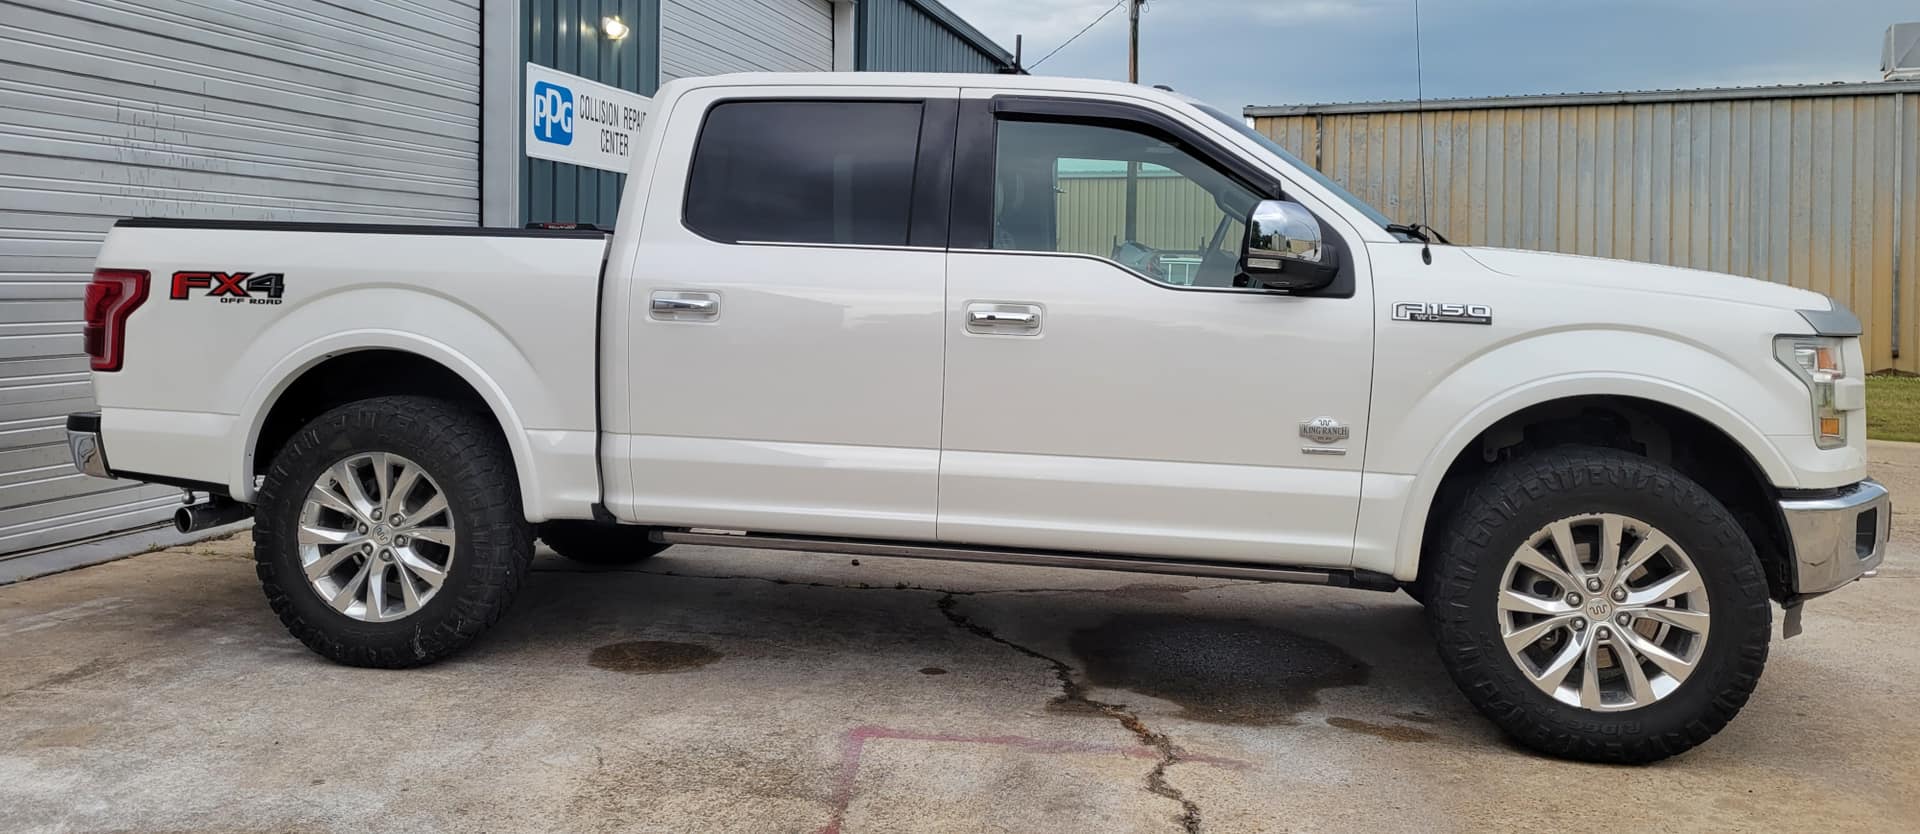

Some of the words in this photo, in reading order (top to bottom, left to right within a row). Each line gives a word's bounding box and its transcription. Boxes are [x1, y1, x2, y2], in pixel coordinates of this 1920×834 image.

[535, 87, 572, 138] PPG
[580, 94, 619, 127] COLLISION
[600, 128, 629, 157] CENTER
[170, 270, 285, 300] FX4
[1303, 424, 1321, 435] KING
[1322, 426, 1347, 436] RANCH
